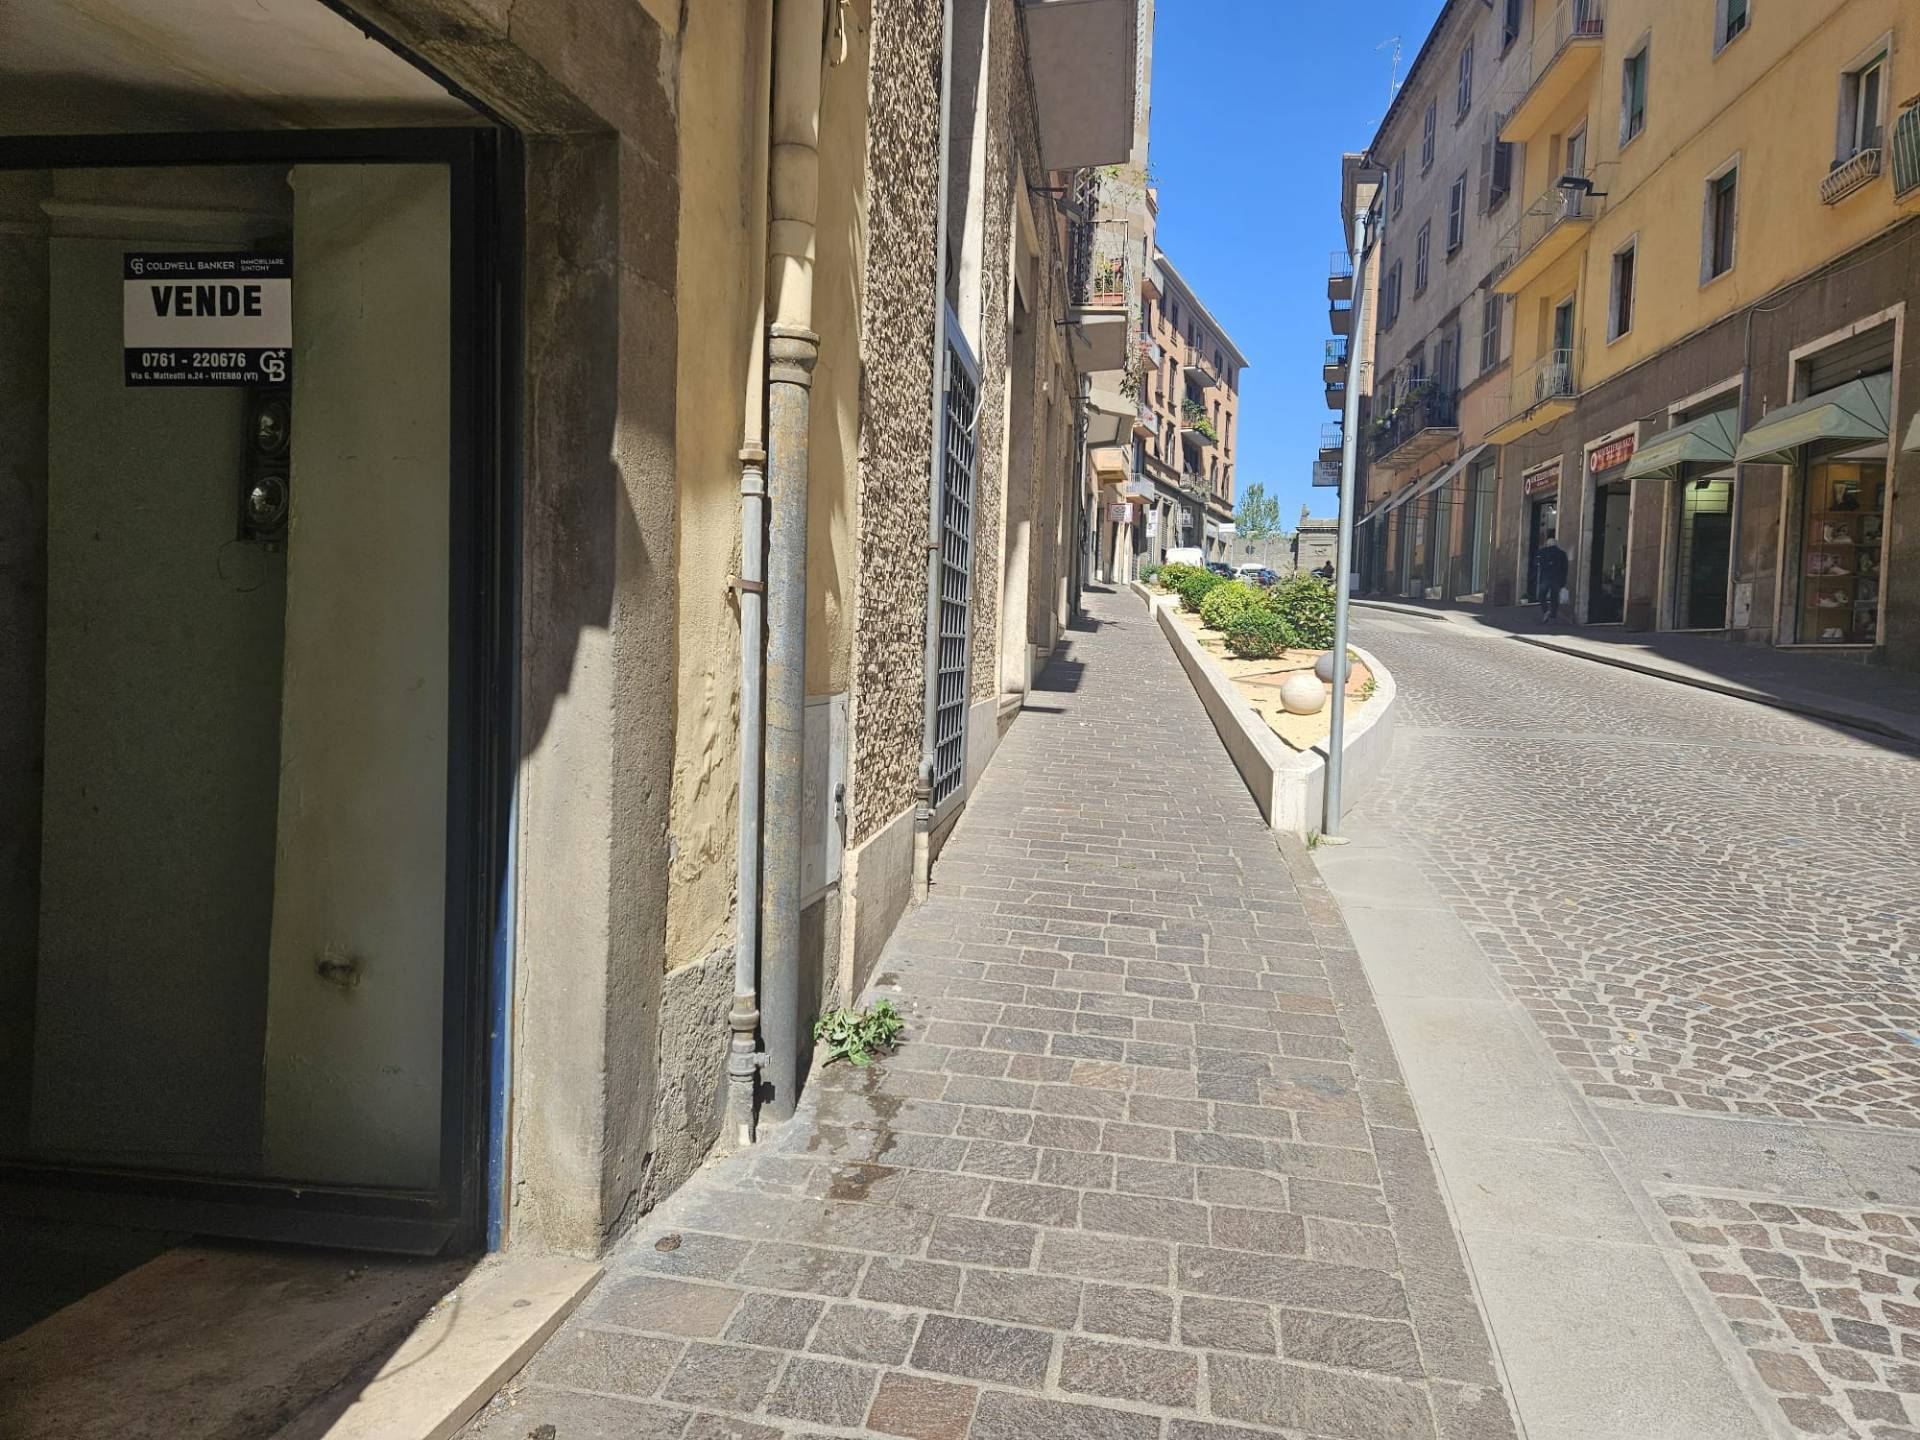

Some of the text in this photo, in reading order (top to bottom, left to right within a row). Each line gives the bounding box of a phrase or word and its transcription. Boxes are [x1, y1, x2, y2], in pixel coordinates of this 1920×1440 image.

[146, 261, 236, 271] COLDWELL BANKER
[150, 285, 262, 317] VENDE
[142, 352, 176, 367] 0761
[192, 352, 246, 367] 220676
[131, 372, 142, 380] Via
[153, 372, 186, 380] Matteotti
[210, 372, 242, 380] VITERBO
[243, 372, 259, 382] (VT)
